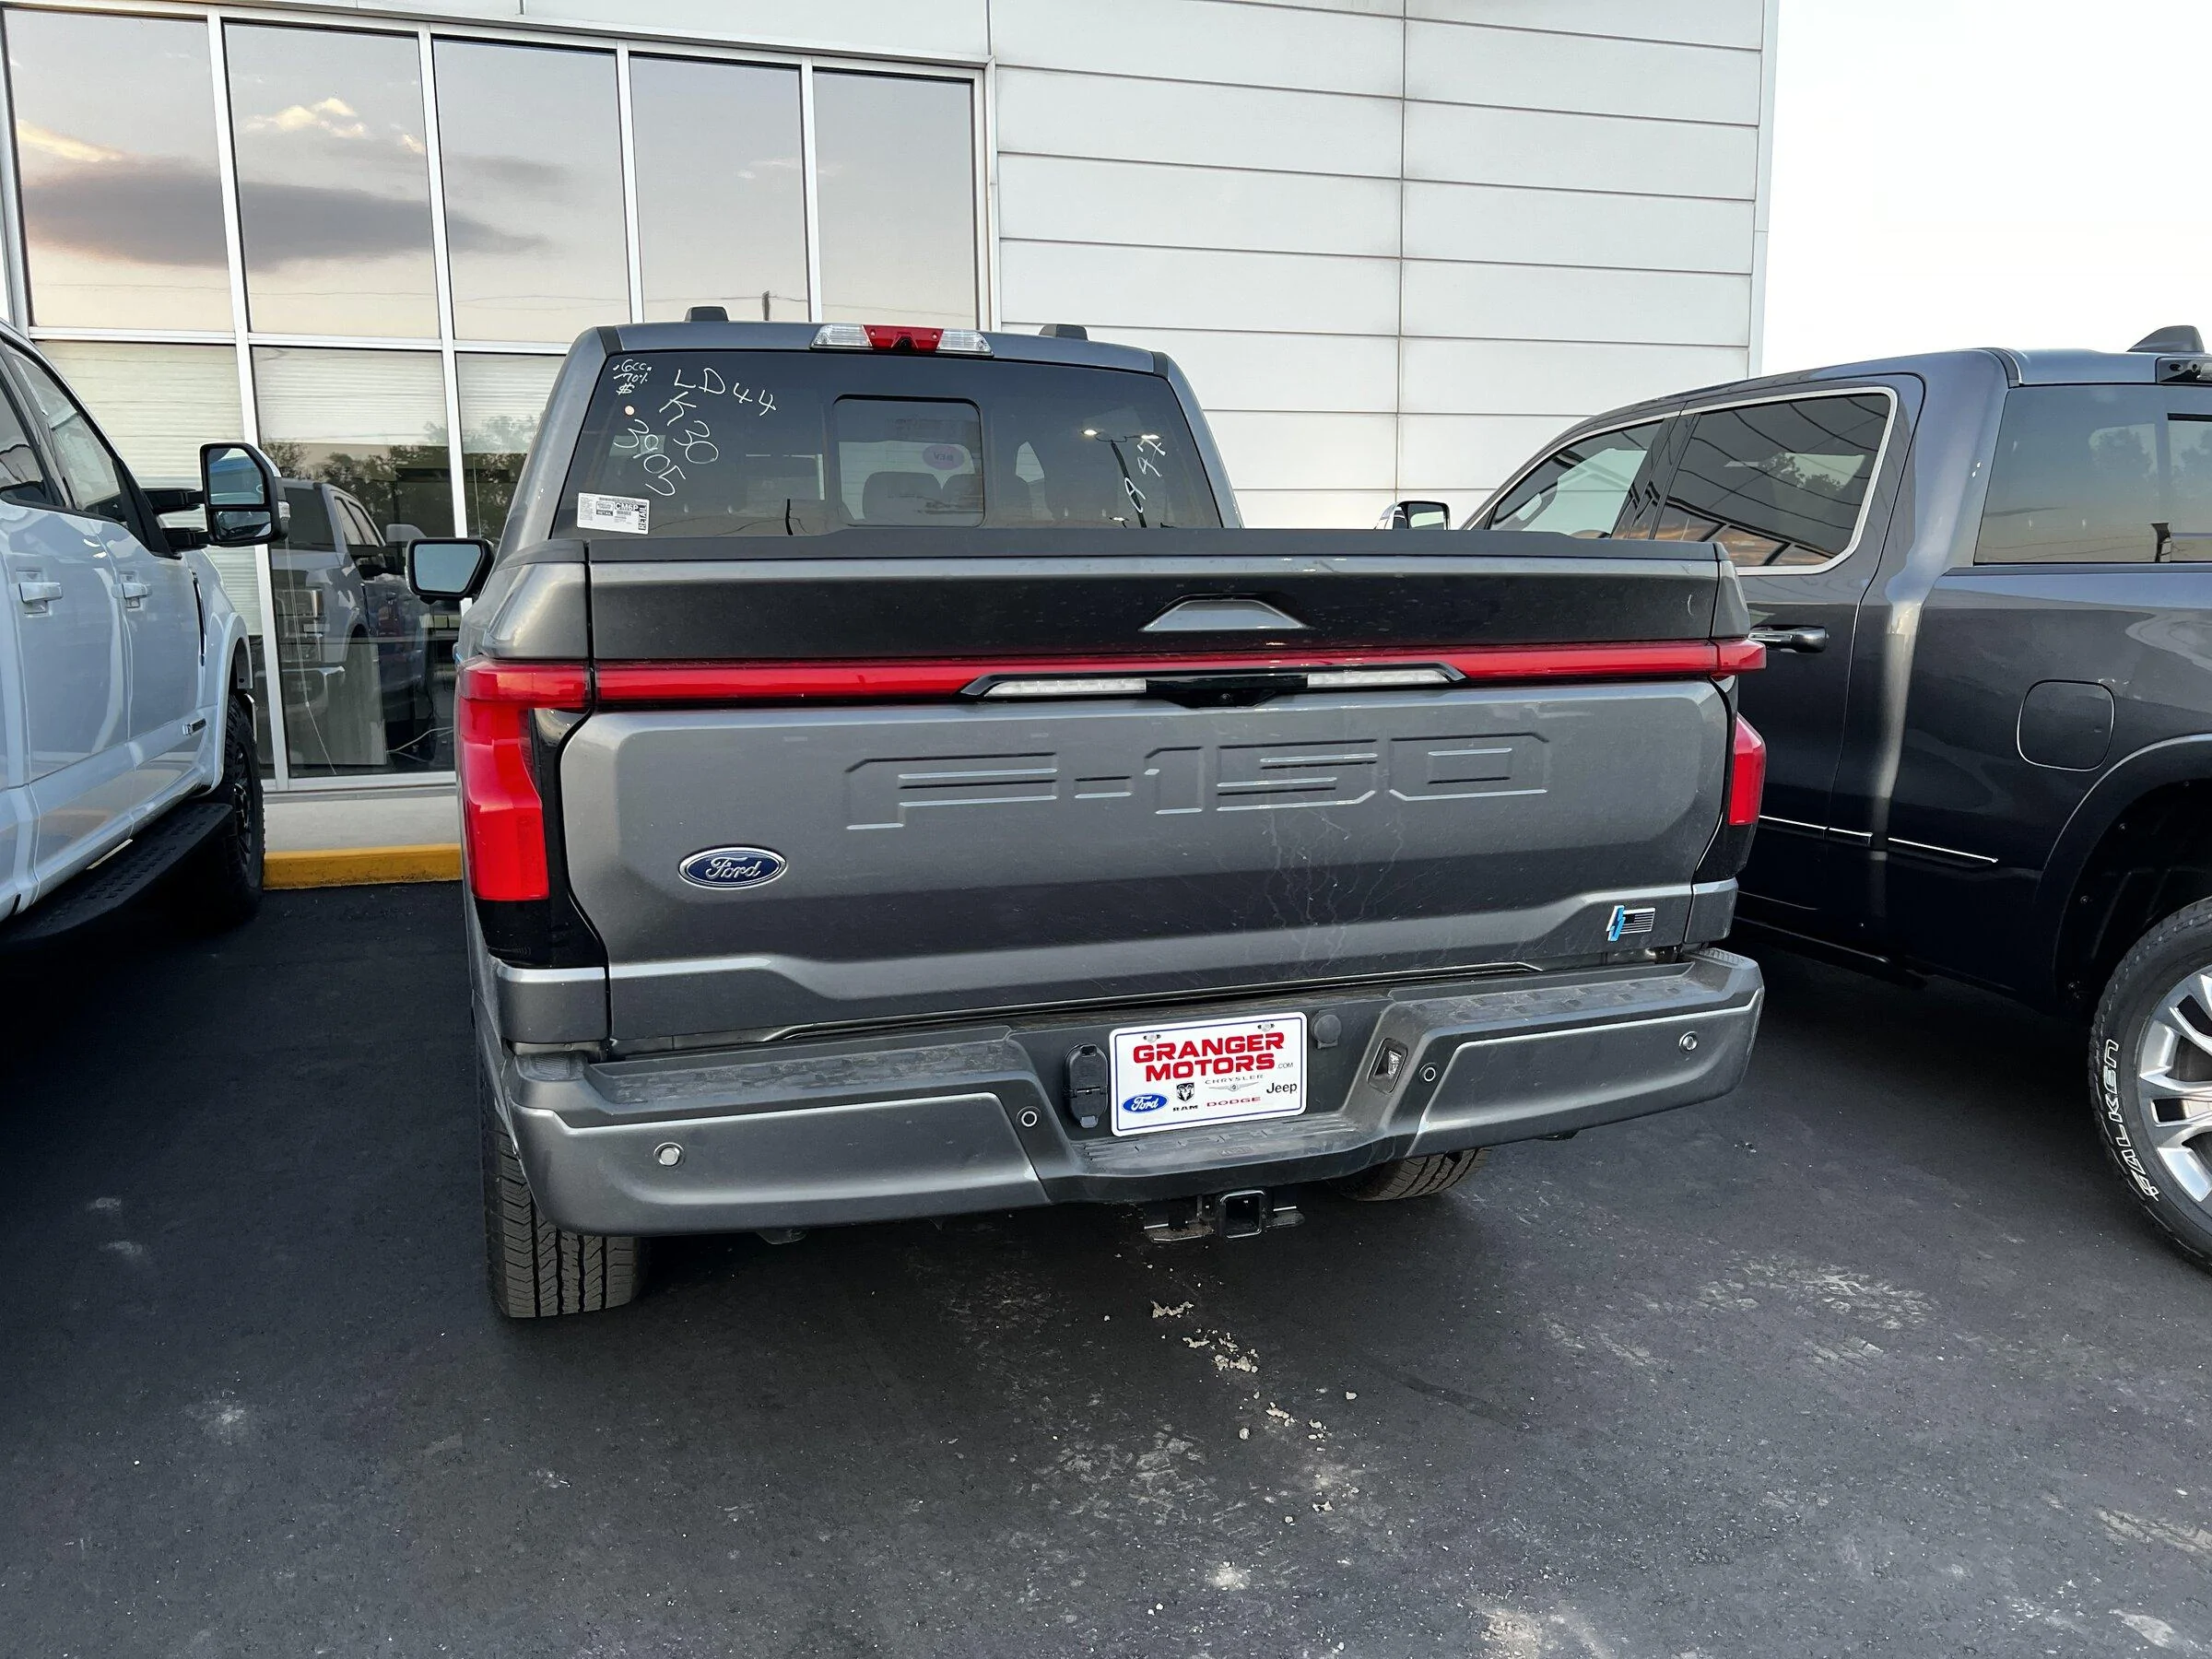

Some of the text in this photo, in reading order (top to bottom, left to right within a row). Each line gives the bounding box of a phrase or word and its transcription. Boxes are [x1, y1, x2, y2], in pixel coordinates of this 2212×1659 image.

[845, 732, 1549, 830] F-150
[705, 856, 763, 879] Ford
[1133, 1031, 1285, 1064] GRANGER
[1146, 1053, 1276, 1082] MOTORS
[1205, 1074, 1265, 1085] CHRYSLER
[1266, 1082, 1298, 1094] Jeep
[1131, 1095, 1159, 1112] Ford
[1206, 1096, 1262, 1107] DODGE
[2102, 1039, 2159, 1201] FALKEN
